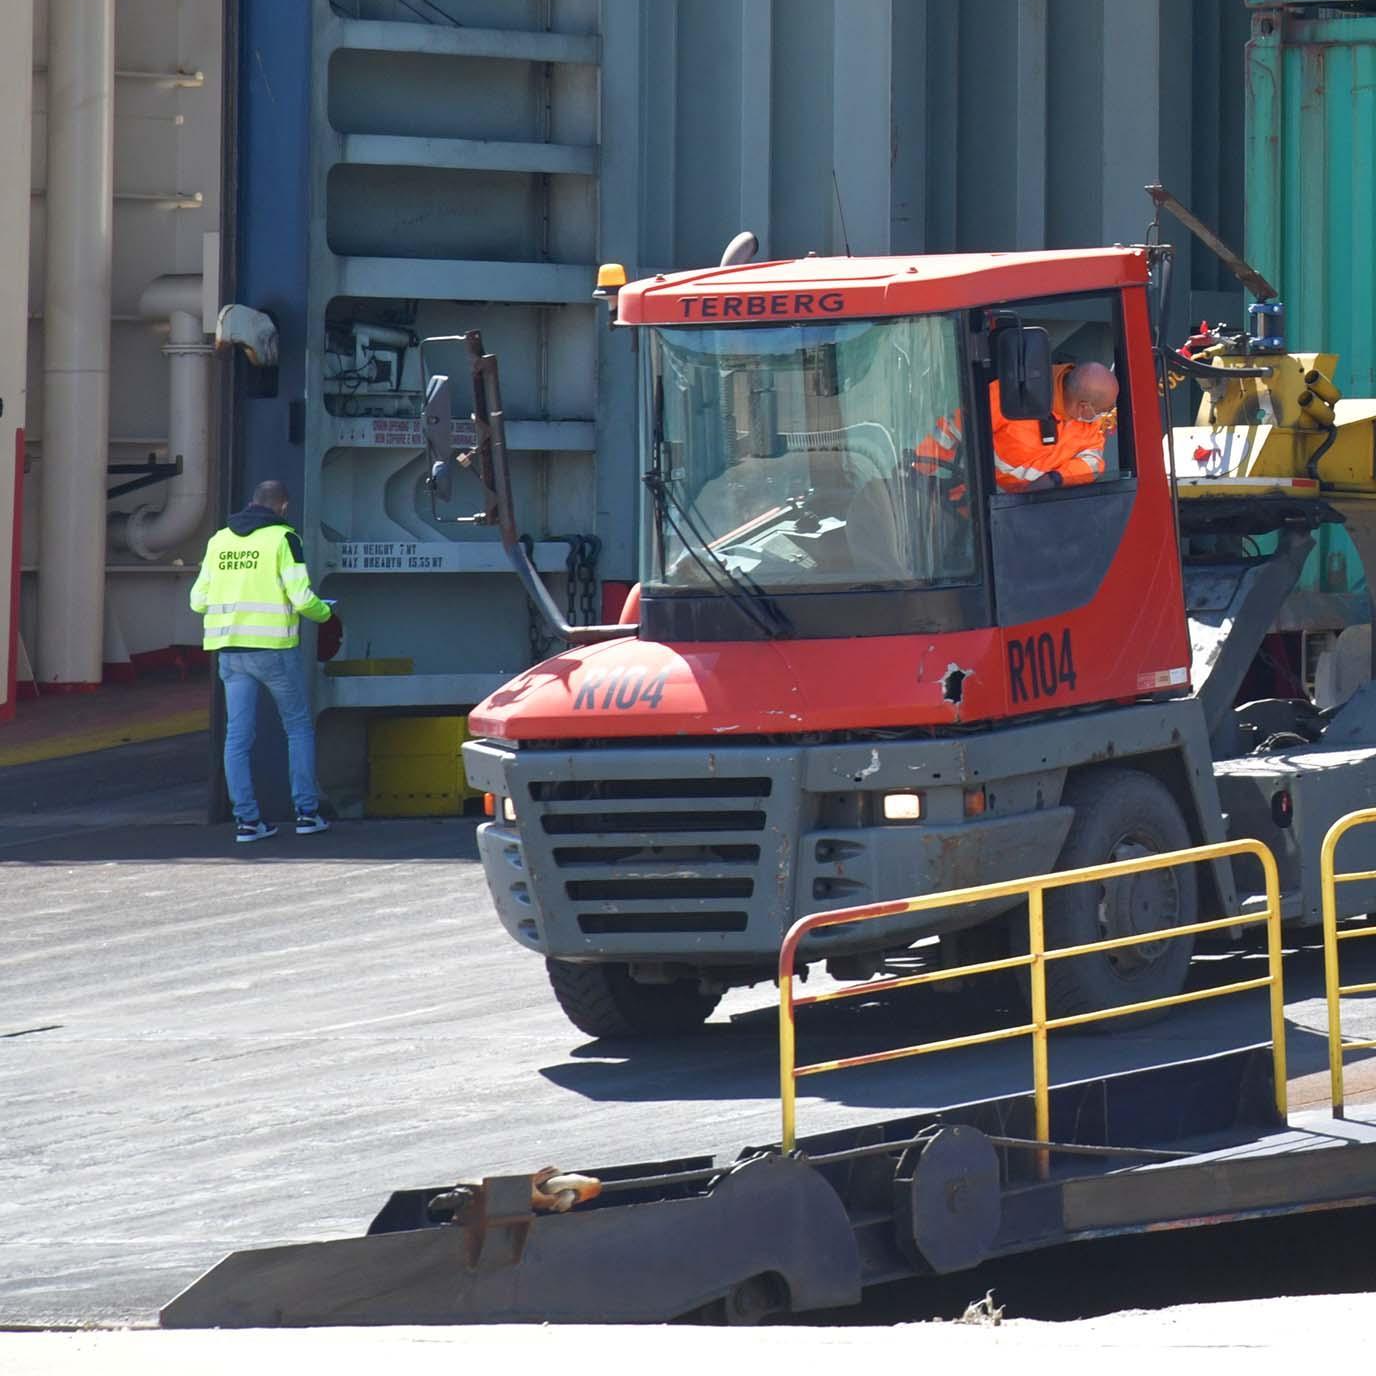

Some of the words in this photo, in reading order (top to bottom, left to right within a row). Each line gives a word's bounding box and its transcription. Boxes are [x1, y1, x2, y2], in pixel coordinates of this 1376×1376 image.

[677, 292, 846, 318] TERBERG
[218, 560, 258, 571] GRENDI
[219, 550, 260, 561] GRUPPO
[1008, 627, 1077, 705] R104
[573, 667, 669, 711] R104
